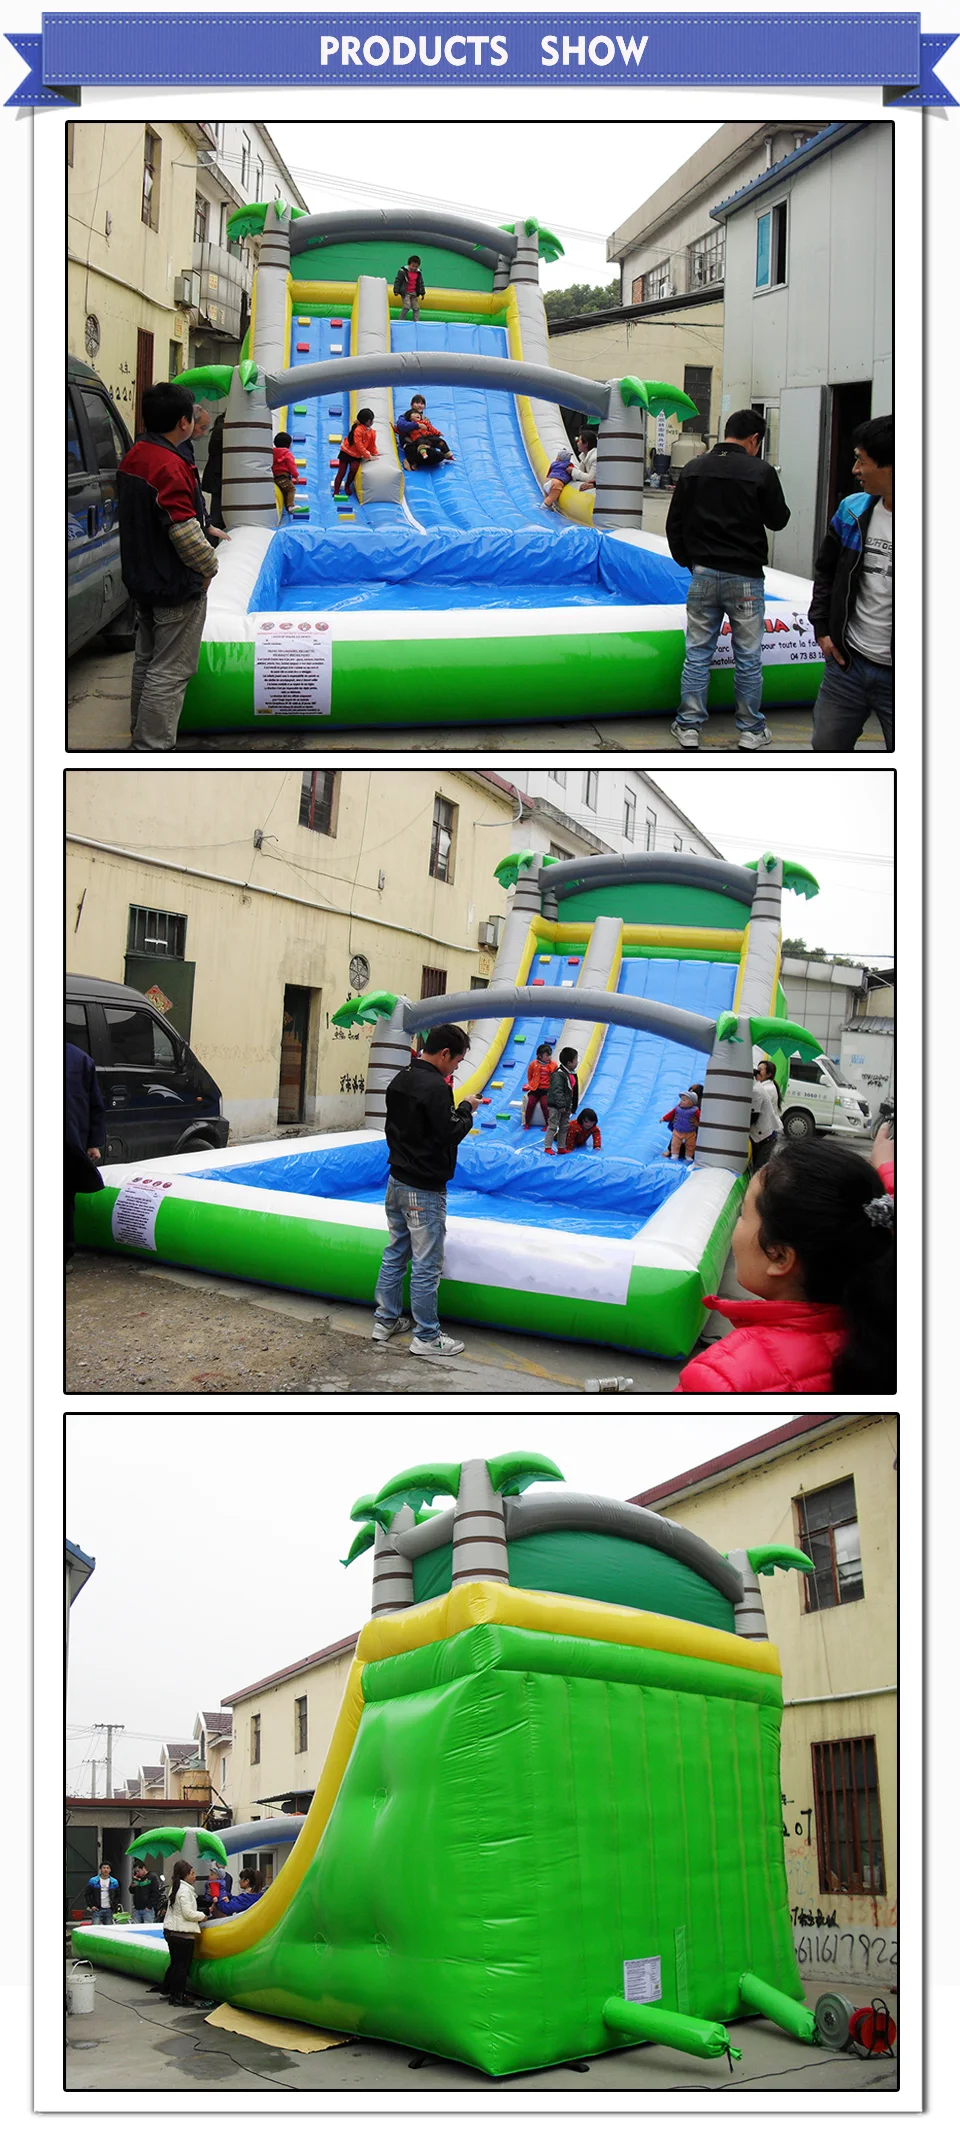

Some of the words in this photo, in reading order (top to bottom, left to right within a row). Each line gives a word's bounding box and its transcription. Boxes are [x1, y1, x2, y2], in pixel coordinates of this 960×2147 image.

[761, 642, 776, 652] pour
[778, 641, 797, 649] toute
[799, 639, 806, 648] la
[790, 653, 798, 661] 04
[799, 652, 808, 660] 73
[809, 652, 817, 660] 83
